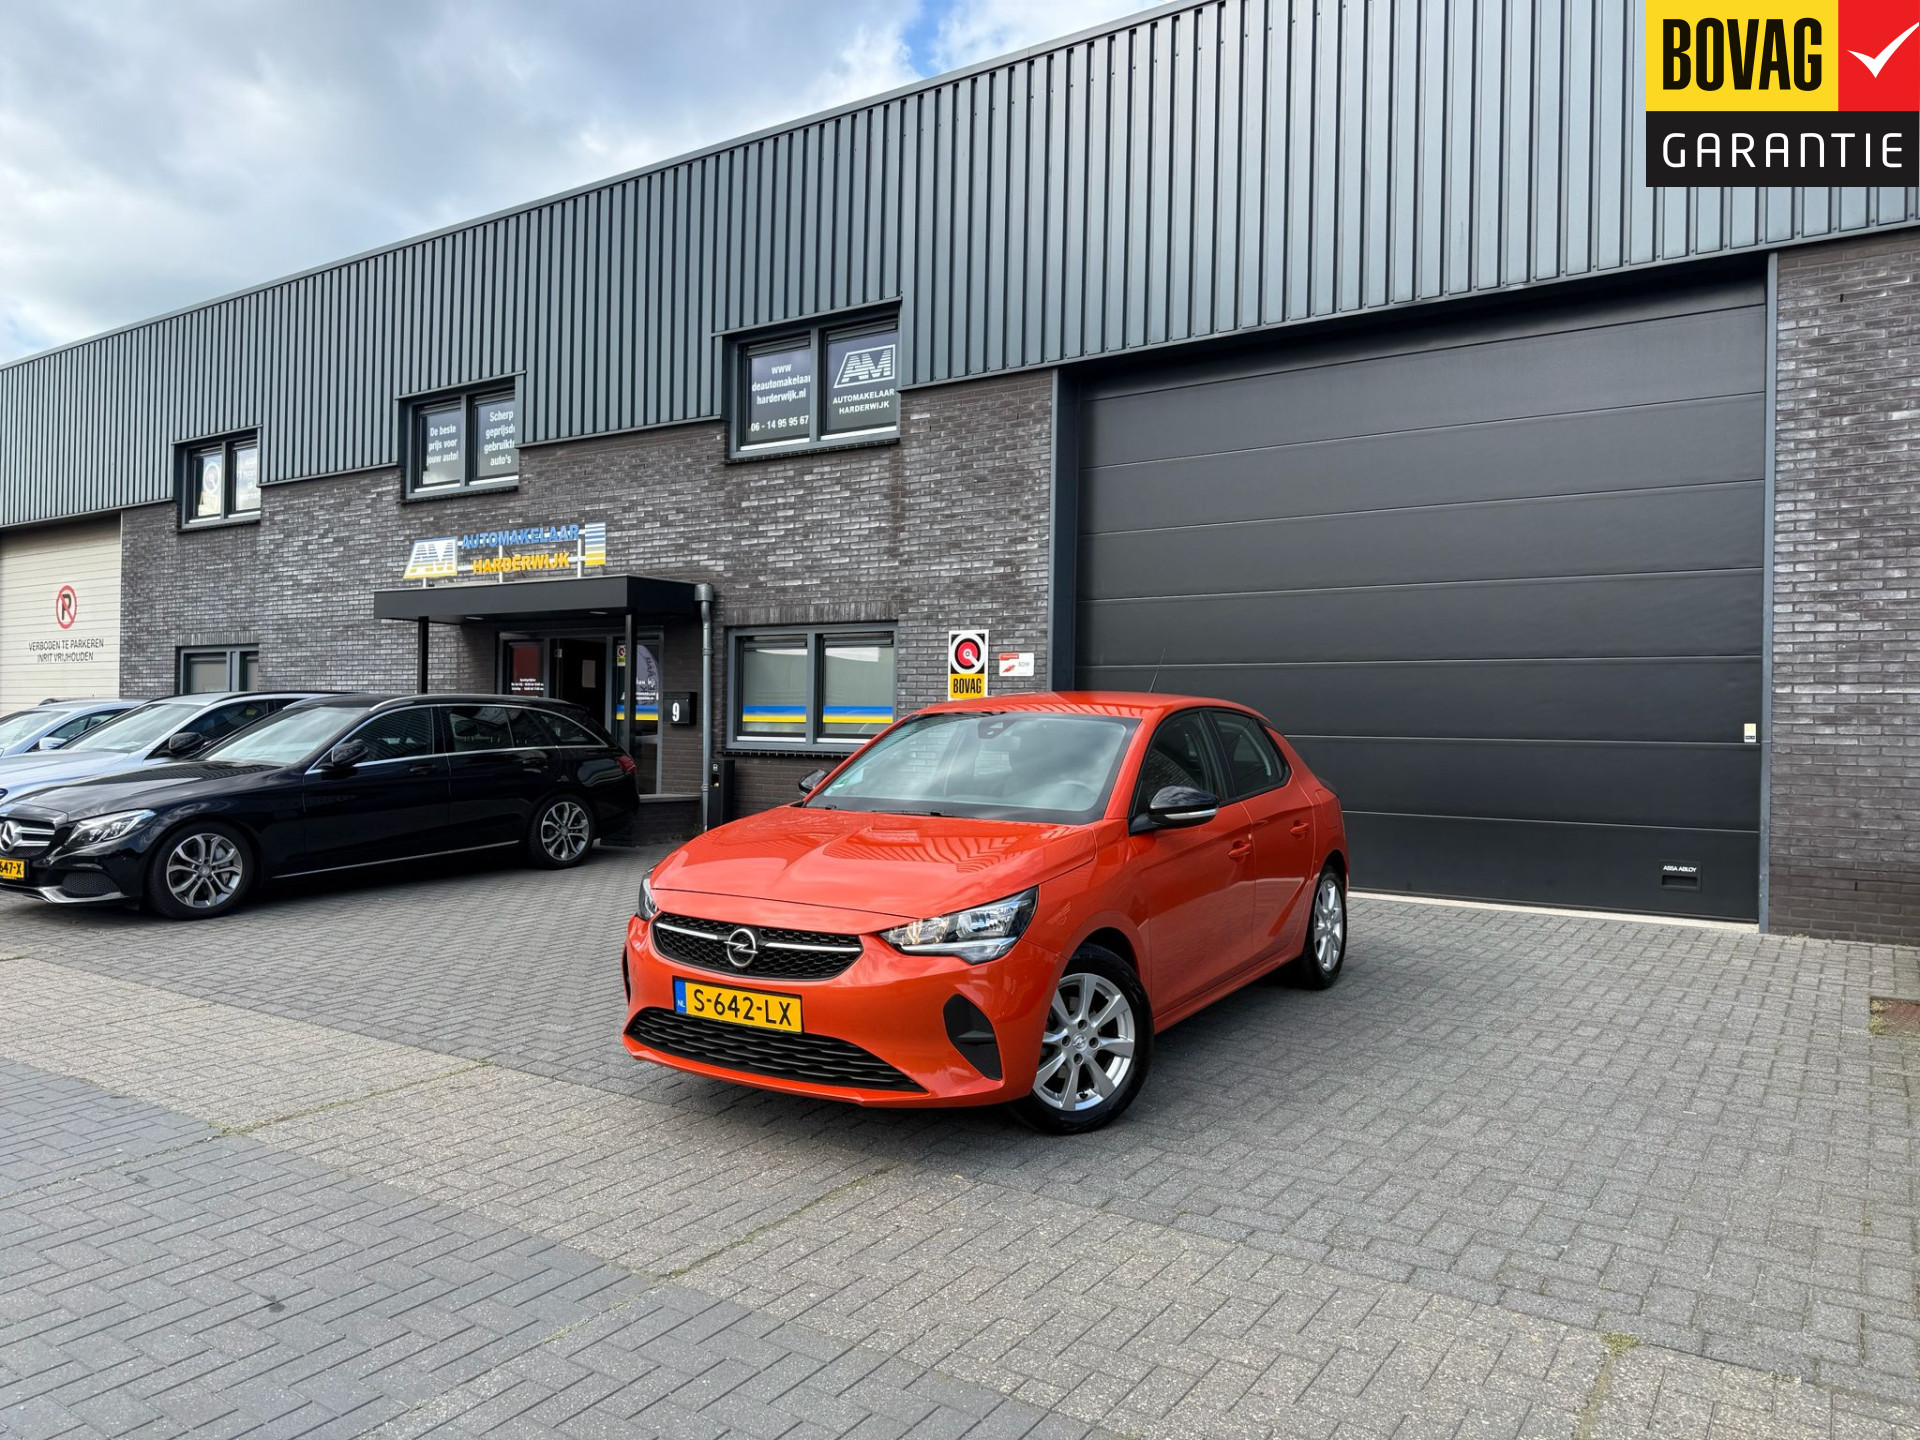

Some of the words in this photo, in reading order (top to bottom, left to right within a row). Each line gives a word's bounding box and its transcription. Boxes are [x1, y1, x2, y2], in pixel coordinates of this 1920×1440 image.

[771, 364, 792, 375] www
[757, 388, 806, 405] harderwijk.nl
[832, 388, 895, 405] AUTOMAKELAAR
[839, 400, 890, 415] HARDERWIJK
[490, 410, 514, 422] Scherp
[751, 422, 760, 432] 06
[767, 420, 776, 430] 14
[778, 419, 787, 428] 95
[789, 417, 798, 426] 95
[800, 415, 809, 425] 67
[430, 427, 438, 437] De
[440, 424, 456, 434] beste
[485, 424, 515, 439] geprijsd
[429, 440, 442, 452] prijs
[444, 438, 458, 447] voor
[427, 454, 441, 466] jouw
[443, 450, 459, 461] auto!
[490, 454, 511, 466] auto's
[460, 524, 580, 550] AUTOMAKELAAR
[473, 551, 570, 575] HARDERWIJK
[29, 640, 60, 651] VERBODEN
[62, 639, 69, 649] TE
[70, 638, 104, 649] PARKEREN
[37, 653, 52, 662] INRIT
[953, 678, 982, 694] BOVAG
[671, 702, 679, 722] 9
[677, 999, 686, 1008] NL
[694, 988, 792, 1026] S-642-LX
